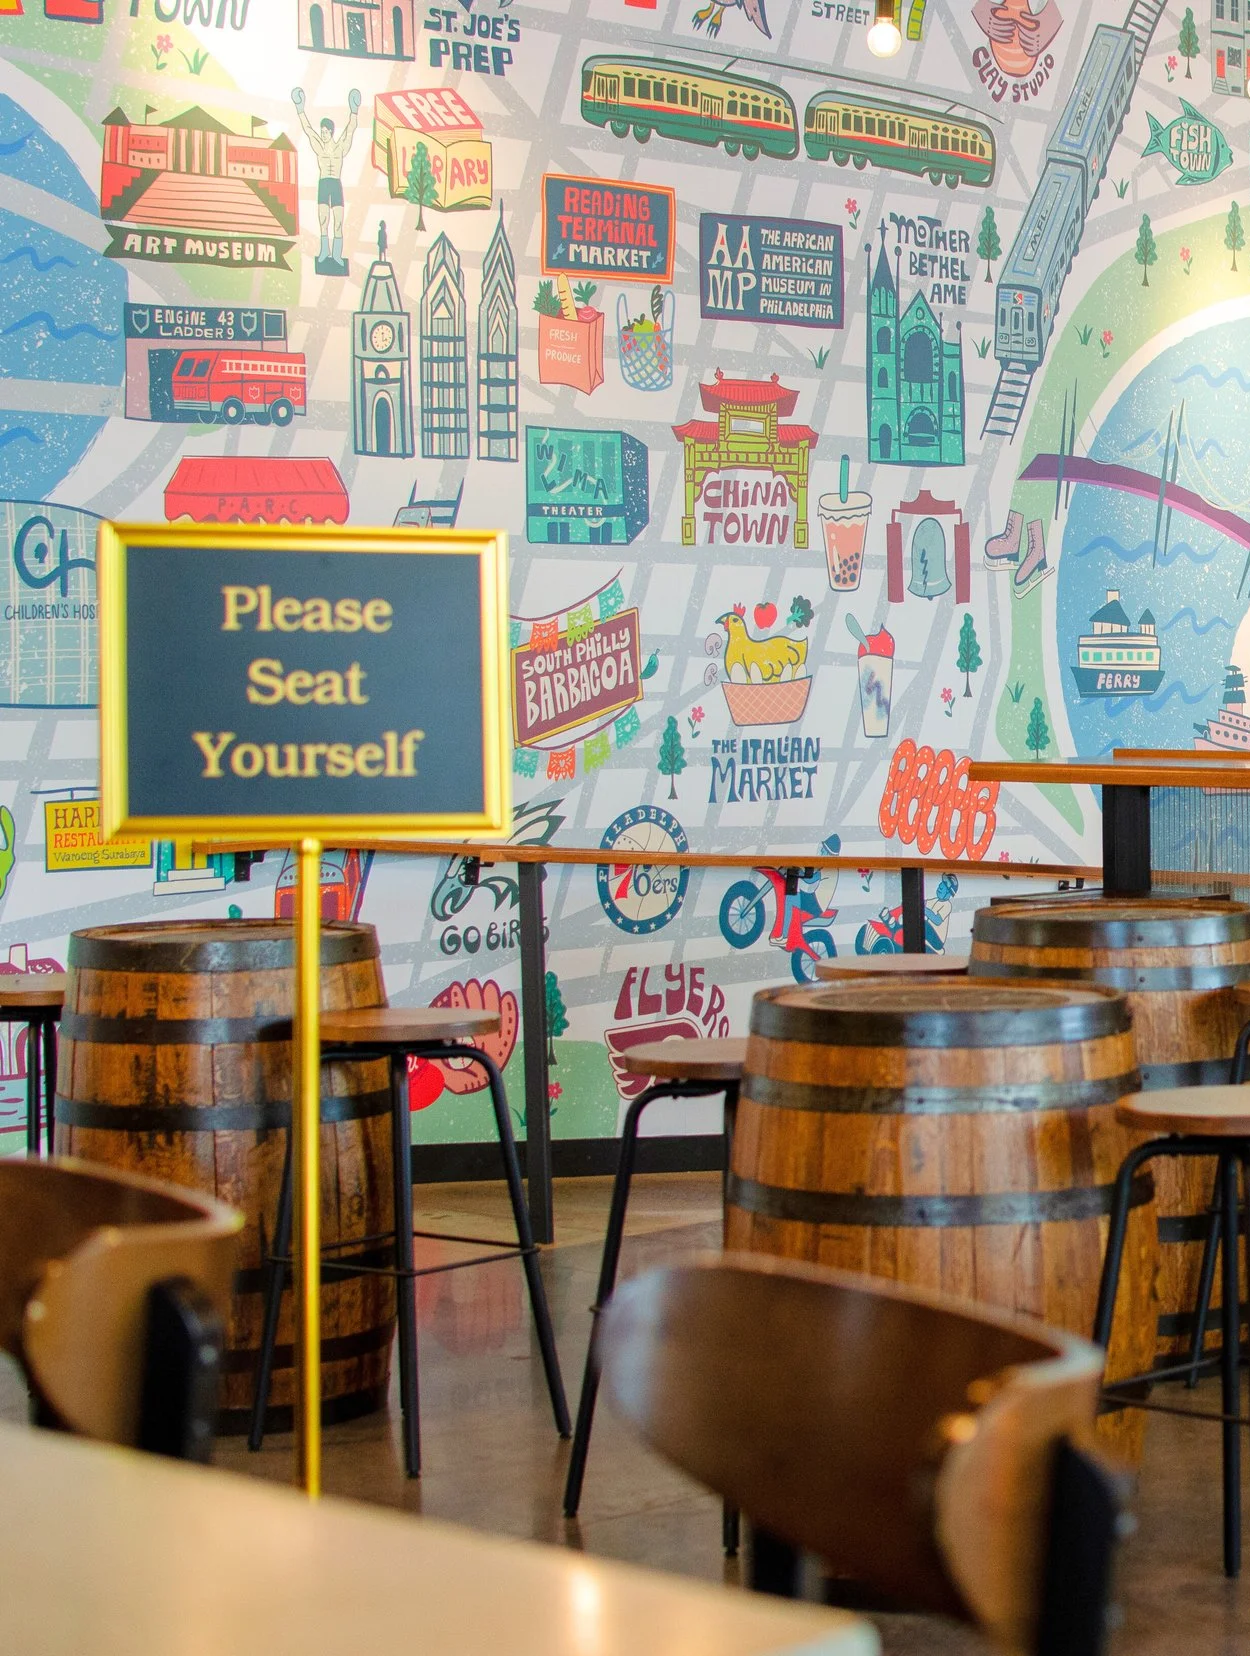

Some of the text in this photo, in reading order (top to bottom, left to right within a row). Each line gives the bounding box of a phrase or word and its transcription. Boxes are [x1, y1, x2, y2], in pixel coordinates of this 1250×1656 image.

[423, 8, 520, 42] ST. JOE'S
[811, 1, 870, 27] STREET
[429, 38, 514, 76] PREP
[973, 46, 1055, 103] CLAY STUDIO
[392, 90, 475, 129] FREE
[1169, 122, 1212, 153] FISH
[1170, 150, 1211, 173] TOWN
[564, 187, 651, 221] READING
[557, 215, 658, 248] TERMINAL
[761, 228, 834, 251] THE AFRICAN
[889, 212, 970, 253] MOTHER
[124, 233, 277, 263] ART MUSEUM
[568, 244, 651, 269] MARKET
[760, 253, 834, 276] AMERICAN
[909, 251, 970, 281] BETHEL
[761, 276, 833, 296] MUSEUM IN
[930, 283, 966, 305] AME
[155, 304, 235, 327] ENGINE 43
[760, 298, 835, 320] PHILADELPHIA
[160, 325, 235, 340] LADDER 9
[549, 328, 578, 342] FRESH
[545, 349, 582, 365] PRODUCE
[703, 479, 789, 509] CHINA
[542, 506, 603, 517] THEATER
[703, 512, 787, 545] TOWN
[4, 604, 69, 620] CHILDREN'S
[221, 584, 394, 633] Please
[522, 626, 631, 680] SOUTH PHILLY
[246, 658, 369, 706] Seat
[525, 655, 635, 729] BARBACOA
[1096, 673, 1141, 690] FERRY
[192, 731, 425, 779] Yourself
[712, 736, 821, 765] THE ITALIAN
[708, 756, 818, 803] MARKET
[54, 848, 146, 864] Waroeng Surabaya
[440, 925, 481, 955] GO
